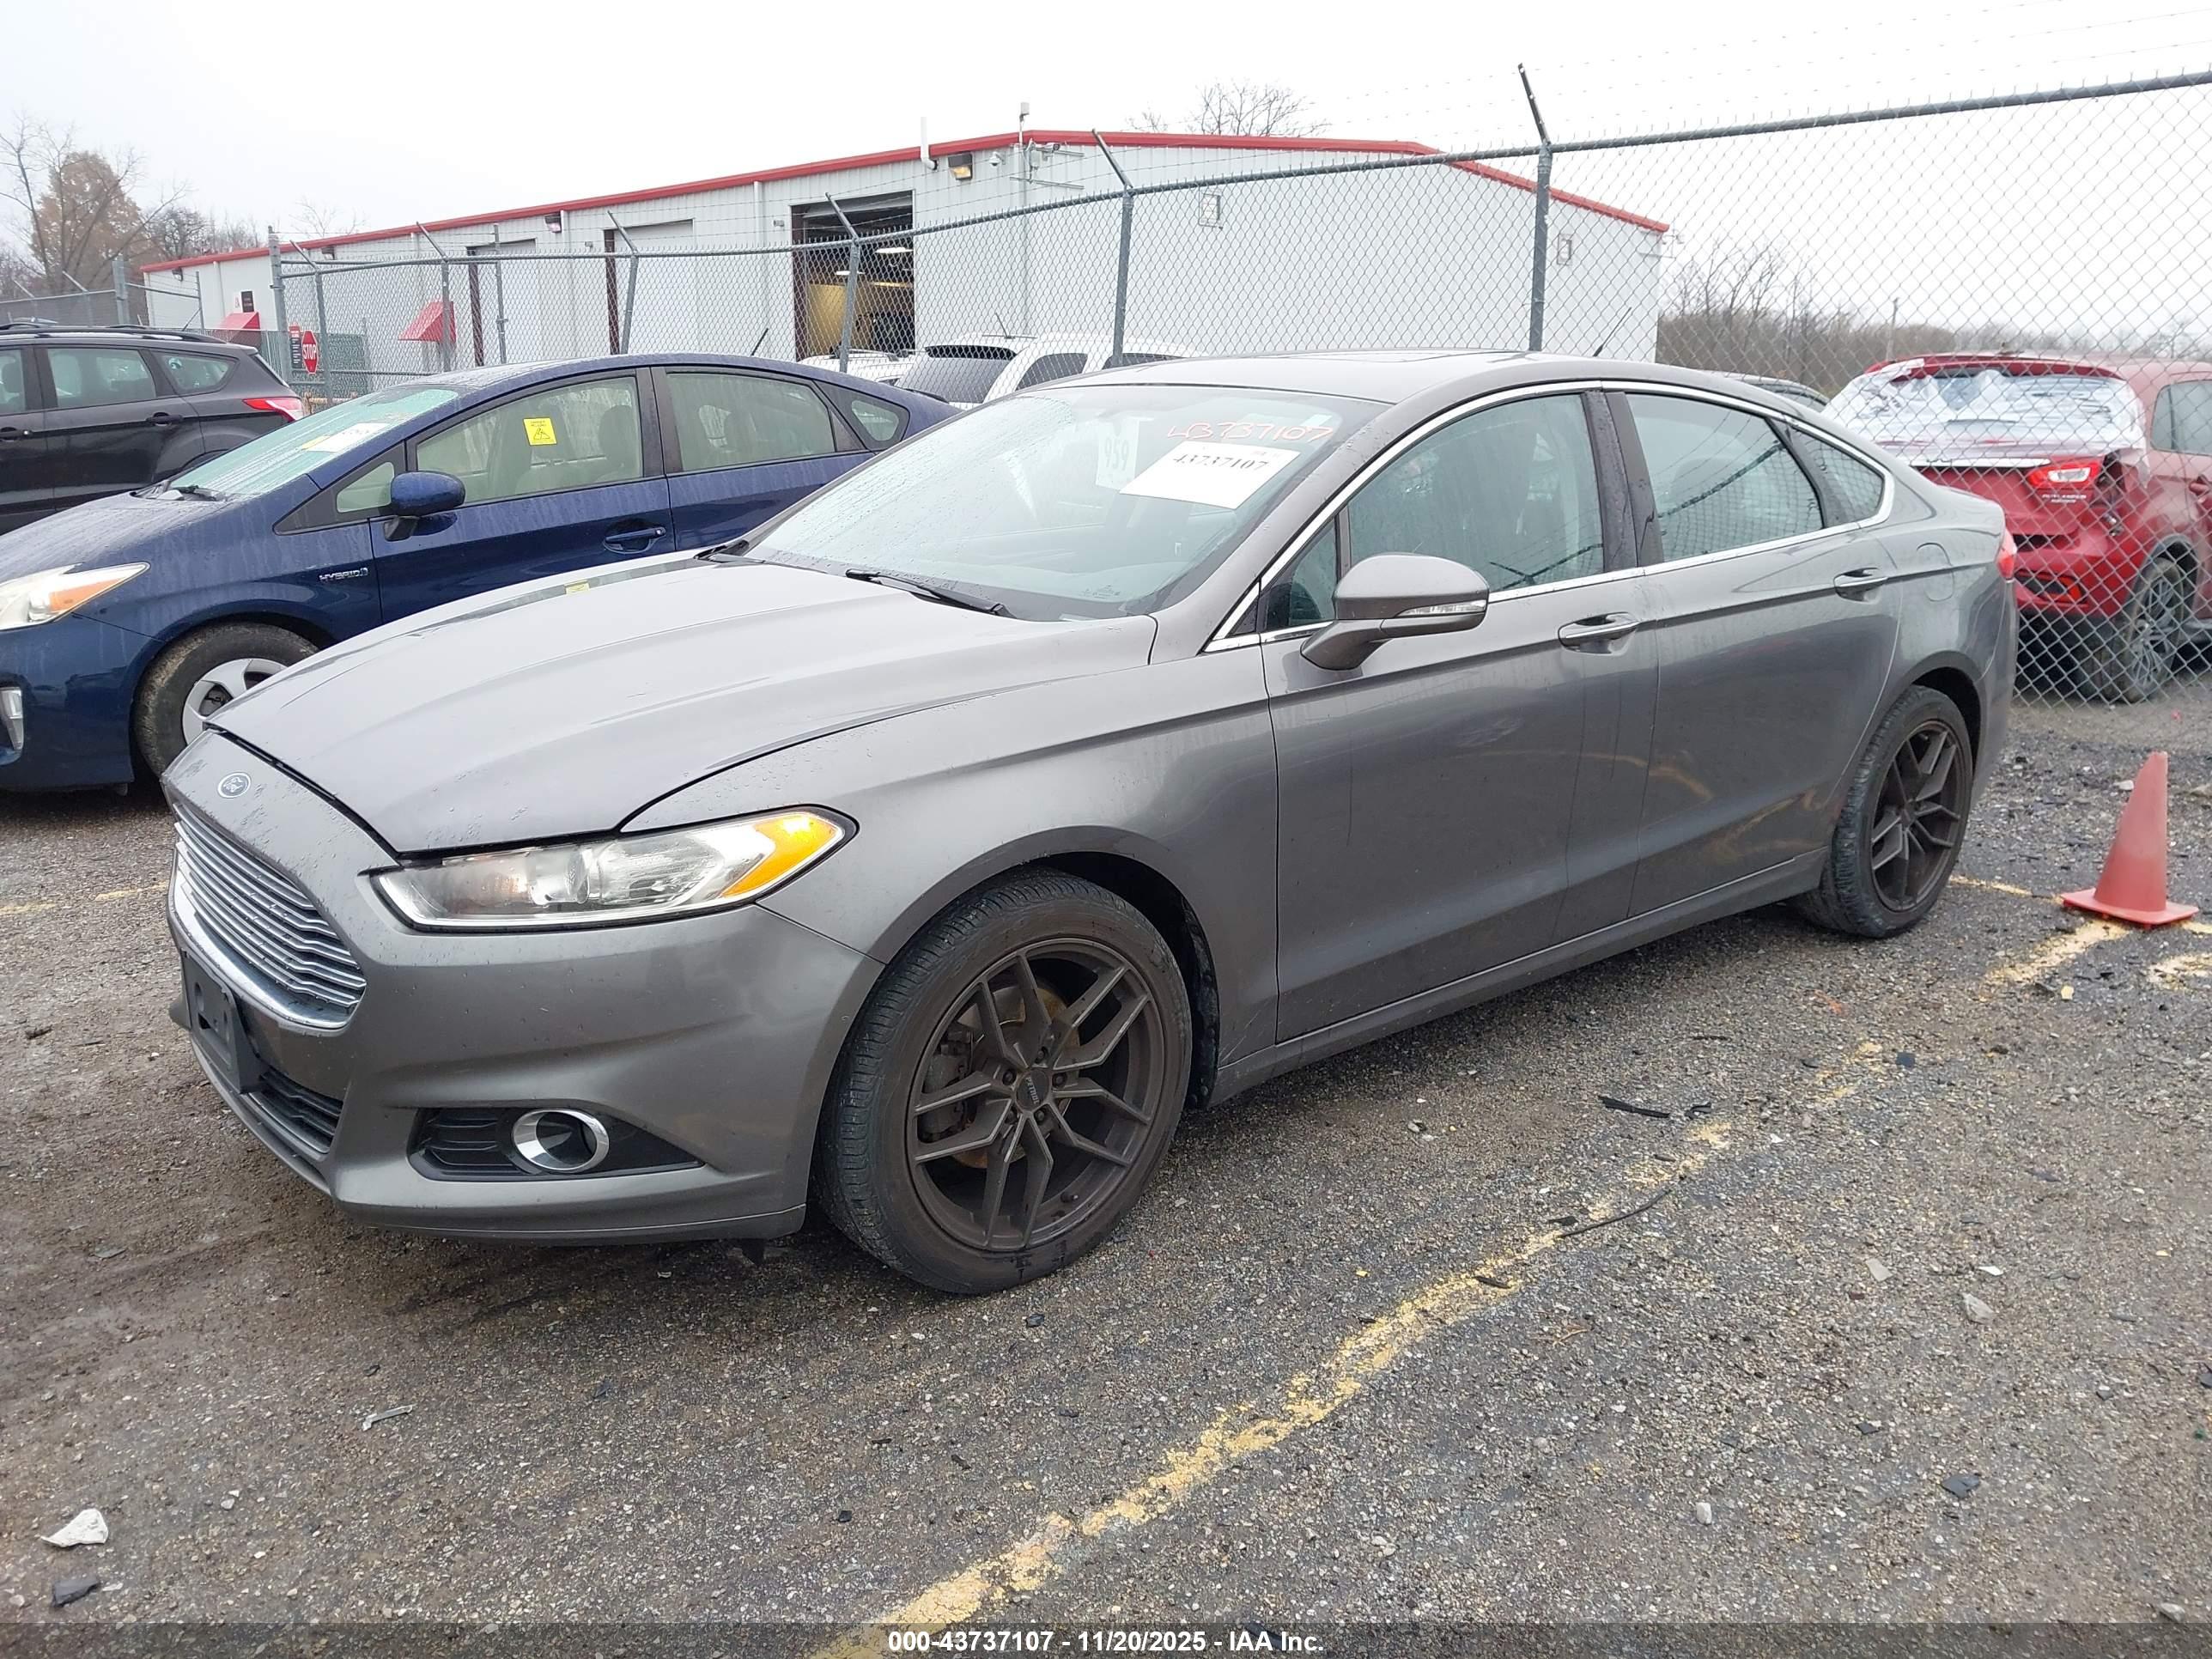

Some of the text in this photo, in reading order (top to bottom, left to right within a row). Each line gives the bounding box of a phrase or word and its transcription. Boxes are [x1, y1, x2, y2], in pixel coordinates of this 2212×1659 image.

[302, 343, 317, 360] STOP
[1167, 422, 1334, 443] 43737107
[1173, 453, 1269, 471] 43737107
[319, 568, 360, 582] HYBRID
